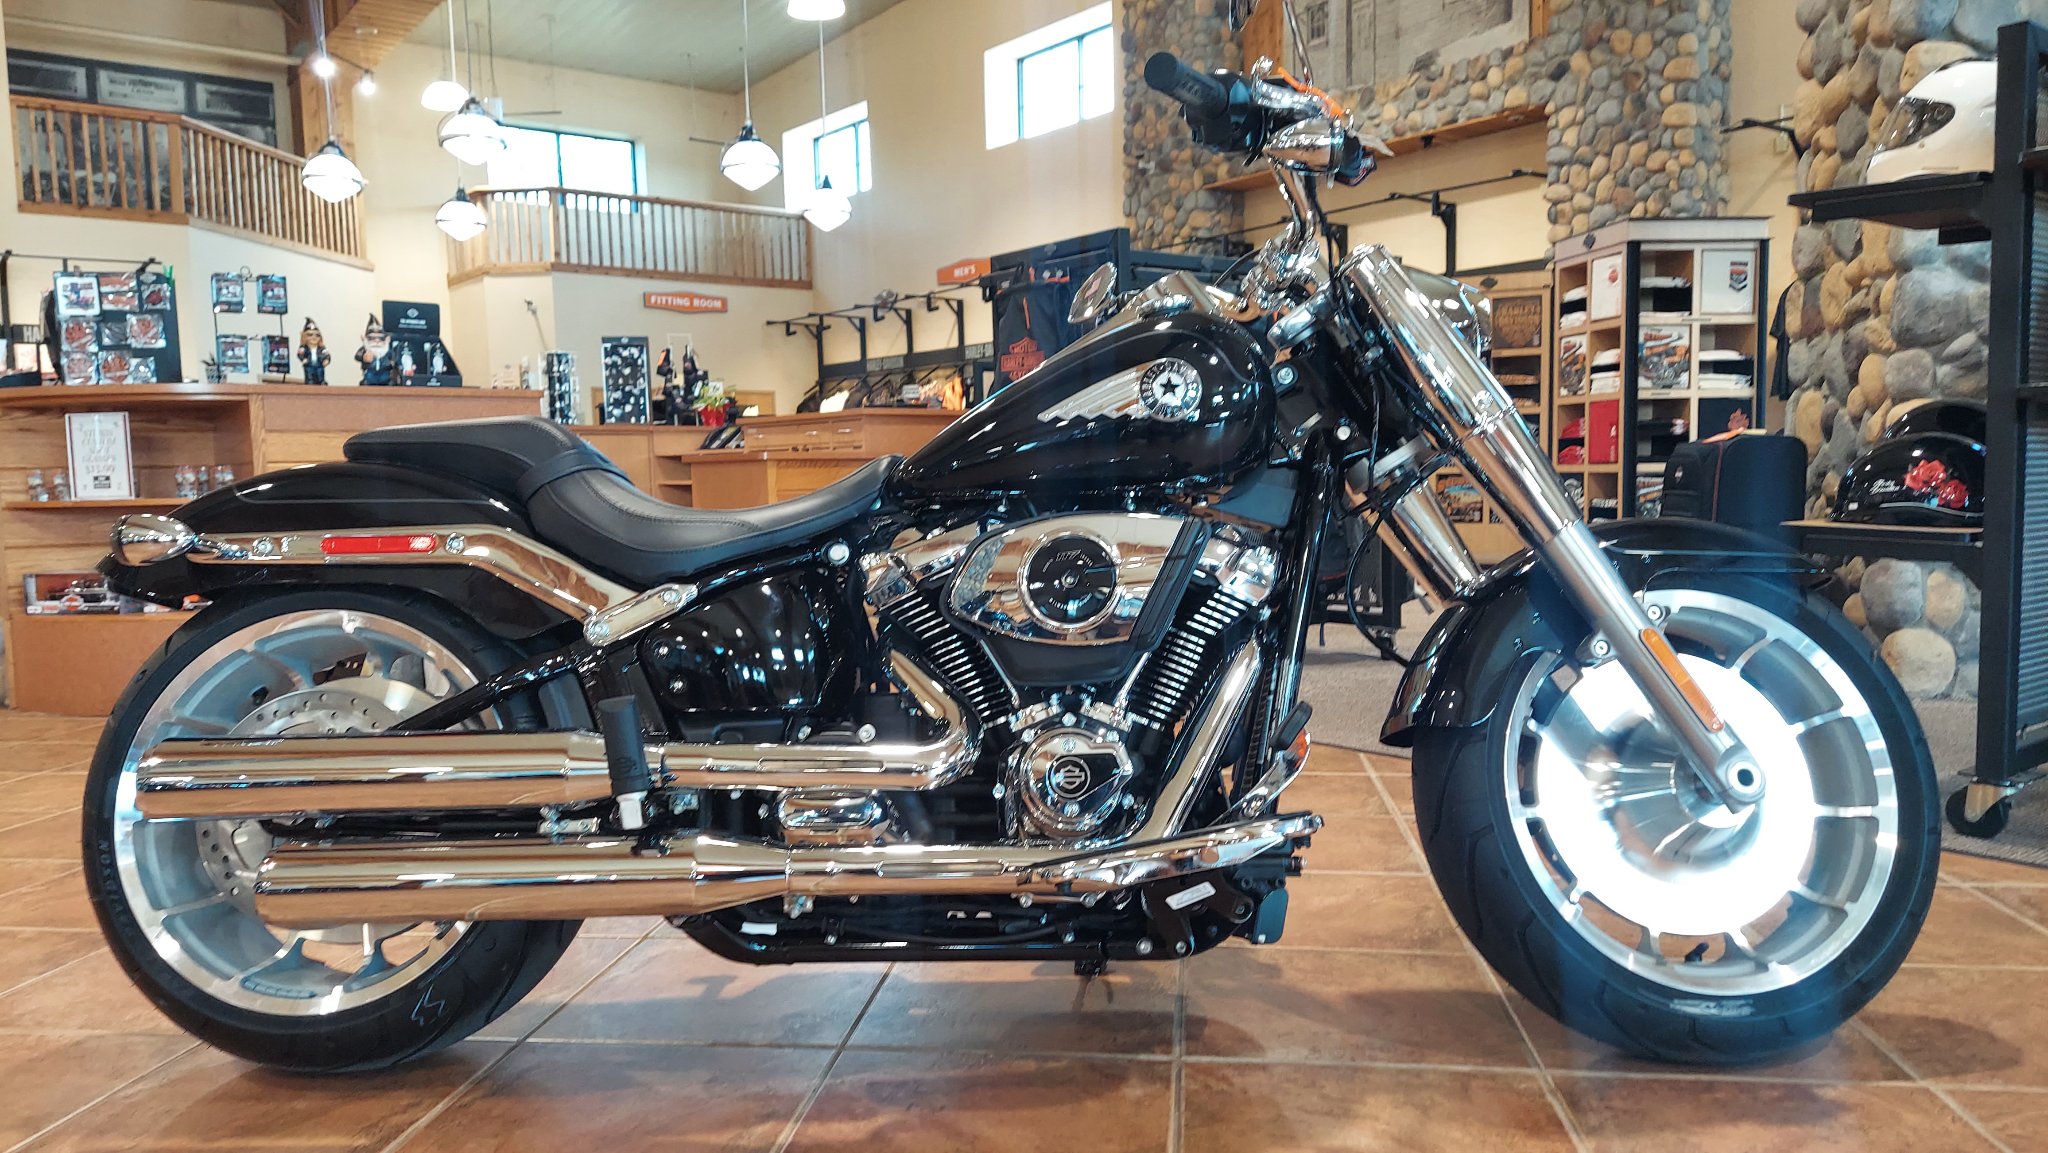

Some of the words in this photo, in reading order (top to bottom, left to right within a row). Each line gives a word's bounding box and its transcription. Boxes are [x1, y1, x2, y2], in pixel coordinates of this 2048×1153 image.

[953, 264, 976, 278] MEN'S
[650, 294, 690, 307] FITTING
[693, 297, 722, 309] ROOM
